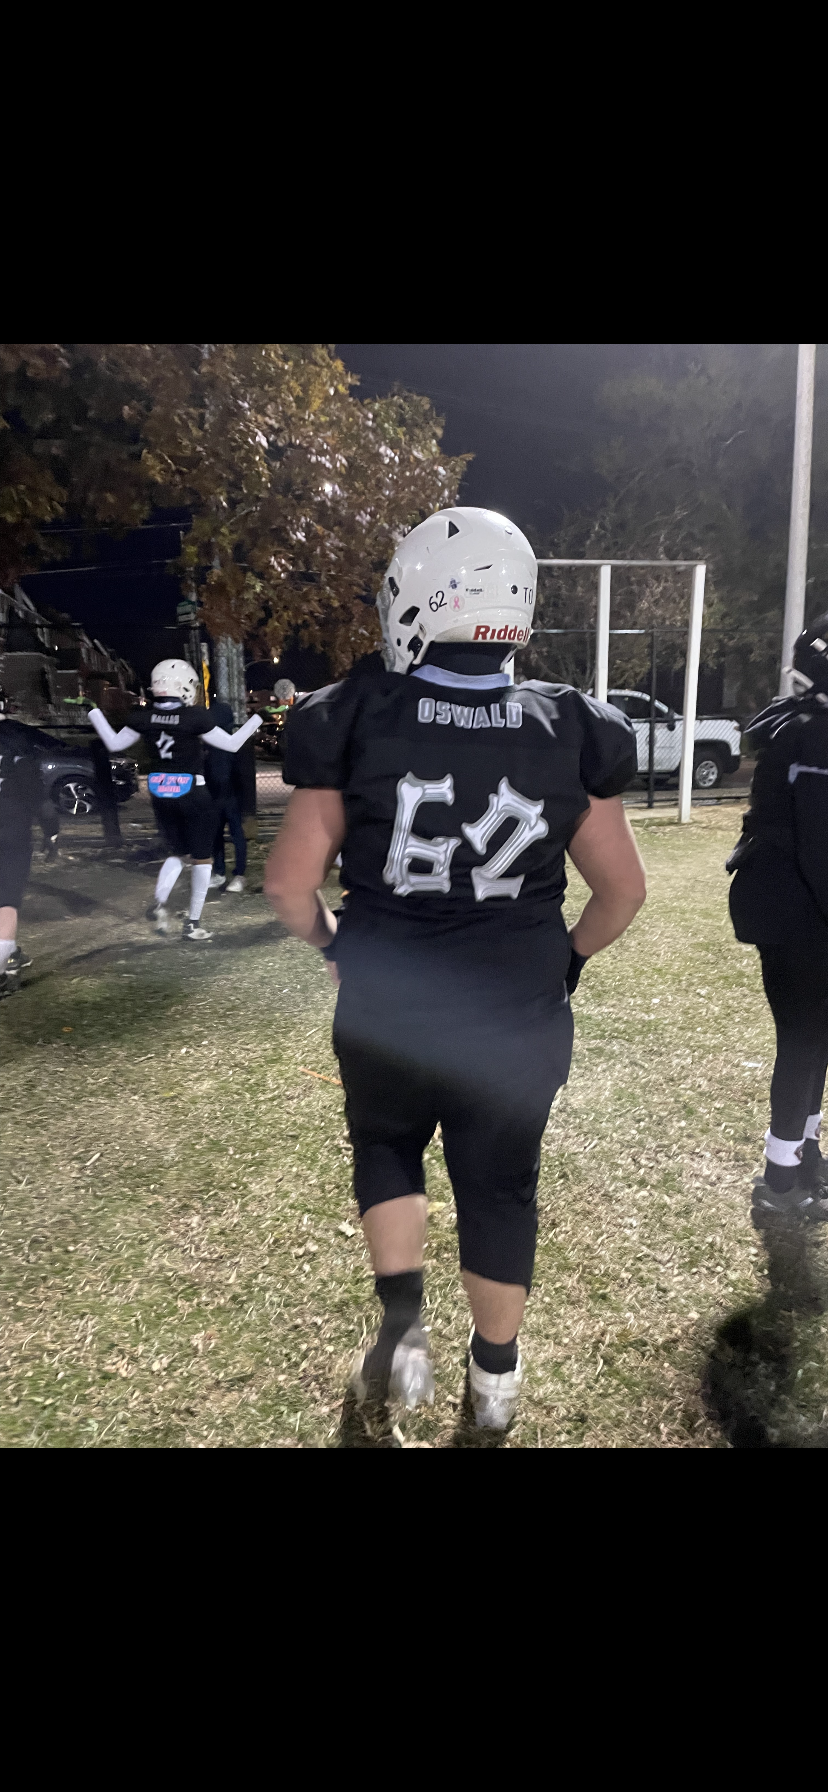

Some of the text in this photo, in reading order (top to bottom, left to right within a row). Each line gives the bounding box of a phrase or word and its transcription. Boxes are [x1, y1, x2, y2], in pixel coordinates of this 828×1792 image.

[428, 590, 448, 613] 62
[473, 624, 530, 643] Riddell
[417, 697, 523, 730] OSWALD
[155, 731, 175, 760] 2
[382, 771, 549, 902] 62
